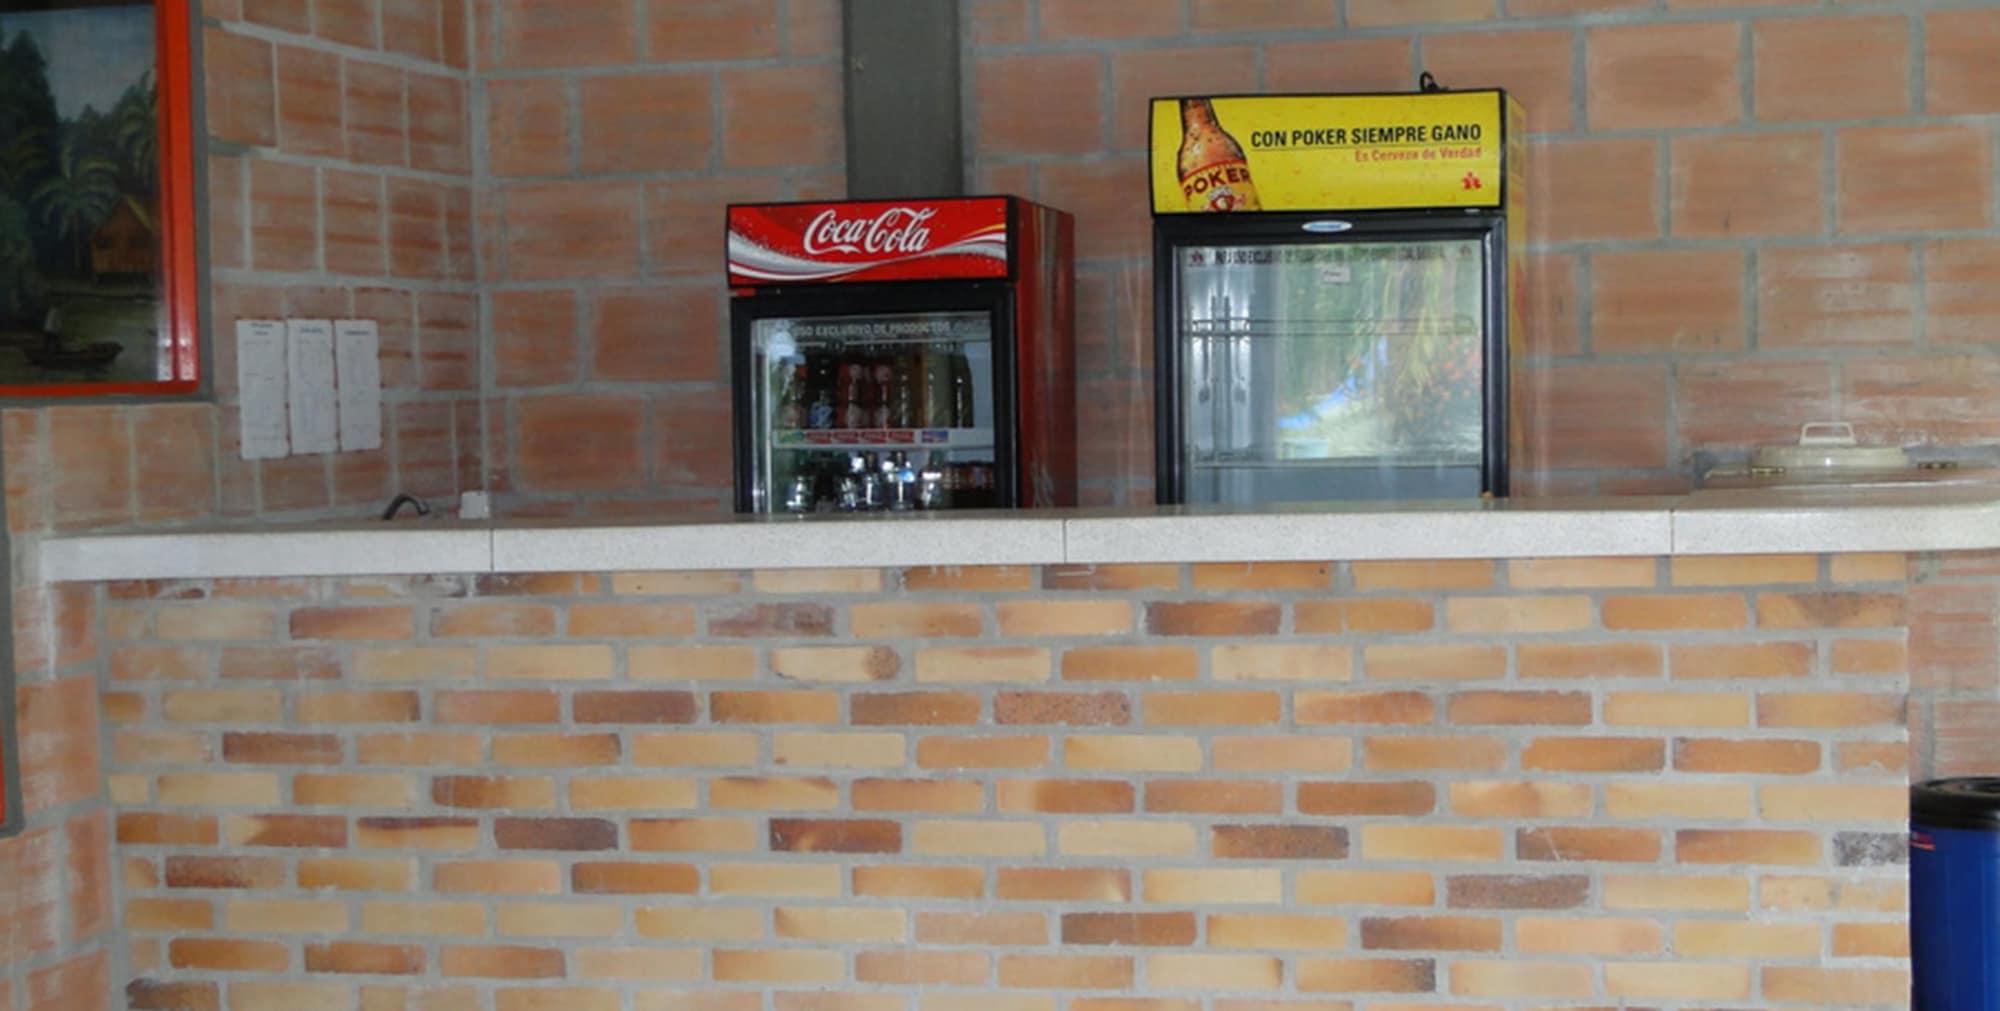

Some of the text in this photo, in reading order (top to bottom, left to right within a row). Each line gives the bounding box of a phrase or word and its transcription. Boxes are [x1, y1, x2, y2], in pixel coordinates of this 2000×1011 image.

[1251, 124, 1481, 148] CON POKER SIEMPRE GANO
[1355, 146, 1482, 162] Es Cerveza de Verdad
[1184, 168, 1250, 198] POKER
[804, 207, 938, 254] Coca-Cola
